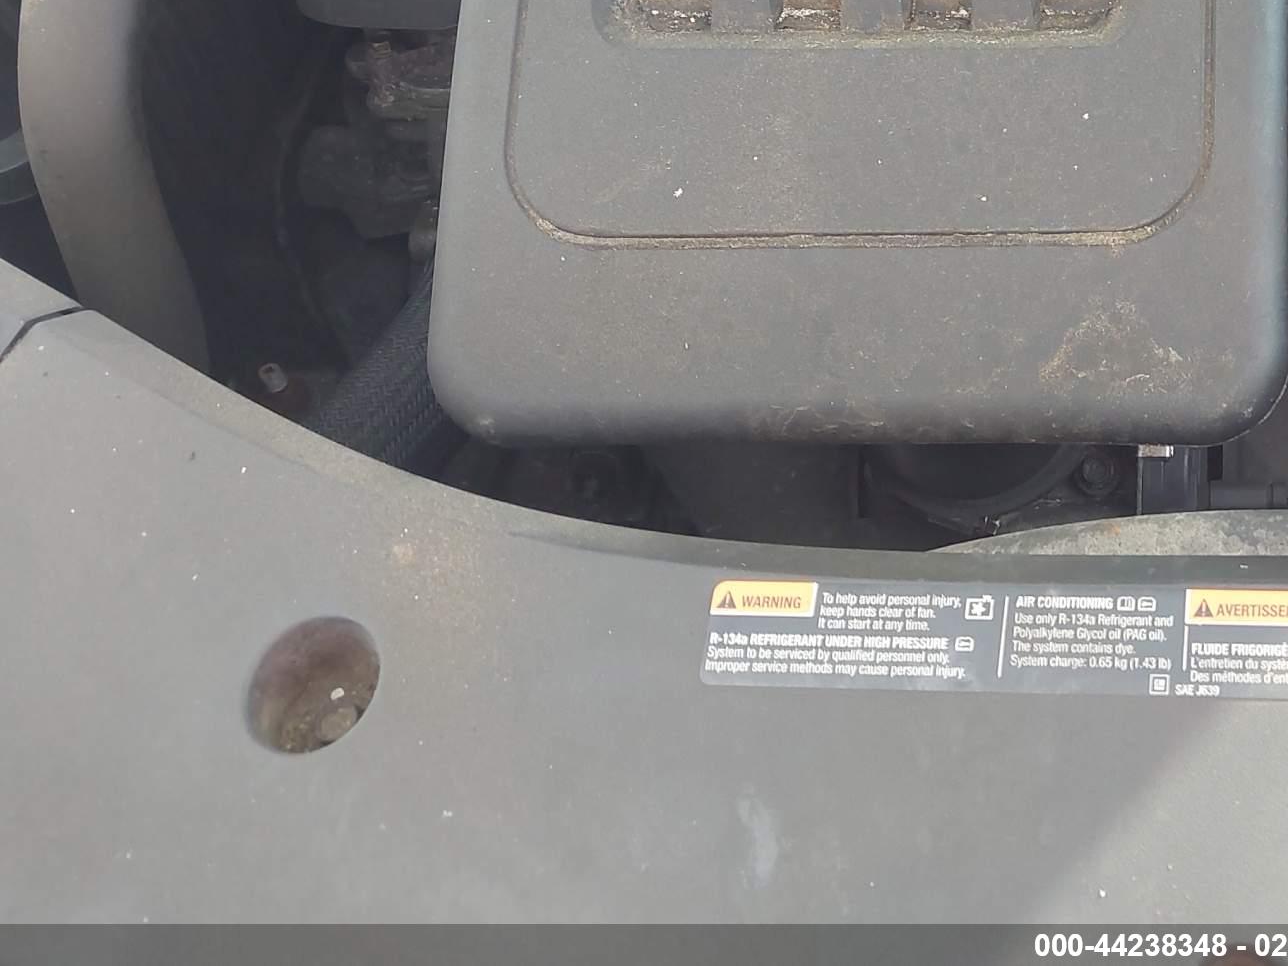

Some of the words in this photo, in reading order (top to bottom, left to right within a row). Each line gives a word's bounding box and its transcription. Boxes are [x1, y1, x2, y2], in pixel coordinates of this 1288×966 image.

[741, 596, 801, 609] WARNING
[822, 593, 834, 604] To
[835, 593, 857, 606] help
[859, 593, 885, 605] avoid
[888, 594, 930, 609] personal
[1016, 596, 1035, 608] AIR
[1037, 596, 1114, 610] CONDITIONING
[820, 606, 845, 620] keep
[847, 607, 875, 617] hands
[879, 607, 902, 618] clear
[905, 608, 915, 618] of
[917, 608, 936, 619] fan.
[1015, 612, 1034, 624] Use
[1036, 613, 1056, 626] only
[1059, 613, 1096, 625] R-134a
[1098, 614, 1152, 628] Refrigerant
[1154, 615, 1174, 627] and
[818, 618, 825, 629] It
[827, 620, 845, 630] can
[848, 619, 870, 630] start
[873, 620, 882, 630] at
[884, 621, 902, 632] any
[906, 620, 930, 631] time.
[709, 632, 748, 646] R-134a
[750, 633, 823, 647] REFRIGERANT
[825, 635, 862, 648] UNDER
[864, 635, 890, 649] HIGH
[892, 636, 949, 650] PRESSURE
[1013, 626, 1074, 641] Polyalkylene
[1077, 627, 1106, 641] Glycol
[1109, 628, 1120, 640] oil
[1123, 629, 1147, 641] (PAG
[1149, 629, 1167, 642] oil).
[1012, 640, 1031, 652] The
[1033, 641, 1069, 654] system
[1071, 642, 1113, 654] contains
[1115, 643, 1136, 655] dye.
[1191, 643, 1229, 656] FLUIDE
[707, 647, 744, 662] System
[747, 648, 757, 660] to
[759, 648, 771, 660] be
[774, 648, 815, 661] serviced
[818, 649, 830, 662] by
[832, 649, 874, 663] qualified
[876, 651, 925, 664] personnel
[927, 652, 950, 665] only.
[1010, 654, 1047, 668] System
[1050, 656, 1087, 669] charge:
[1089, 656, 1112, 668] 0.65
[1114, 657, 1127, 671] kg
[1130, 657, 1157, 671] (1.43
[1158, 658, 1171, 671] lb)
[705, 659, 750, 674] Improper
[752, 661, 787, 673] service
[789, 661, 833, 674] methods
[835, 665, 857, 677] may
[859, 665, 888, 676] cause
[890, 664, 933, 678] personal
[935, 664, 966, 679] injury.
[1245, 658, 1258, 670] du
[1190, 671, 1209, 682] Des
[1212, 671, 1261, 684] méthodes
[1175, 684, 1195, 695] SAE
[1196, 685, 1220, 696] J639
